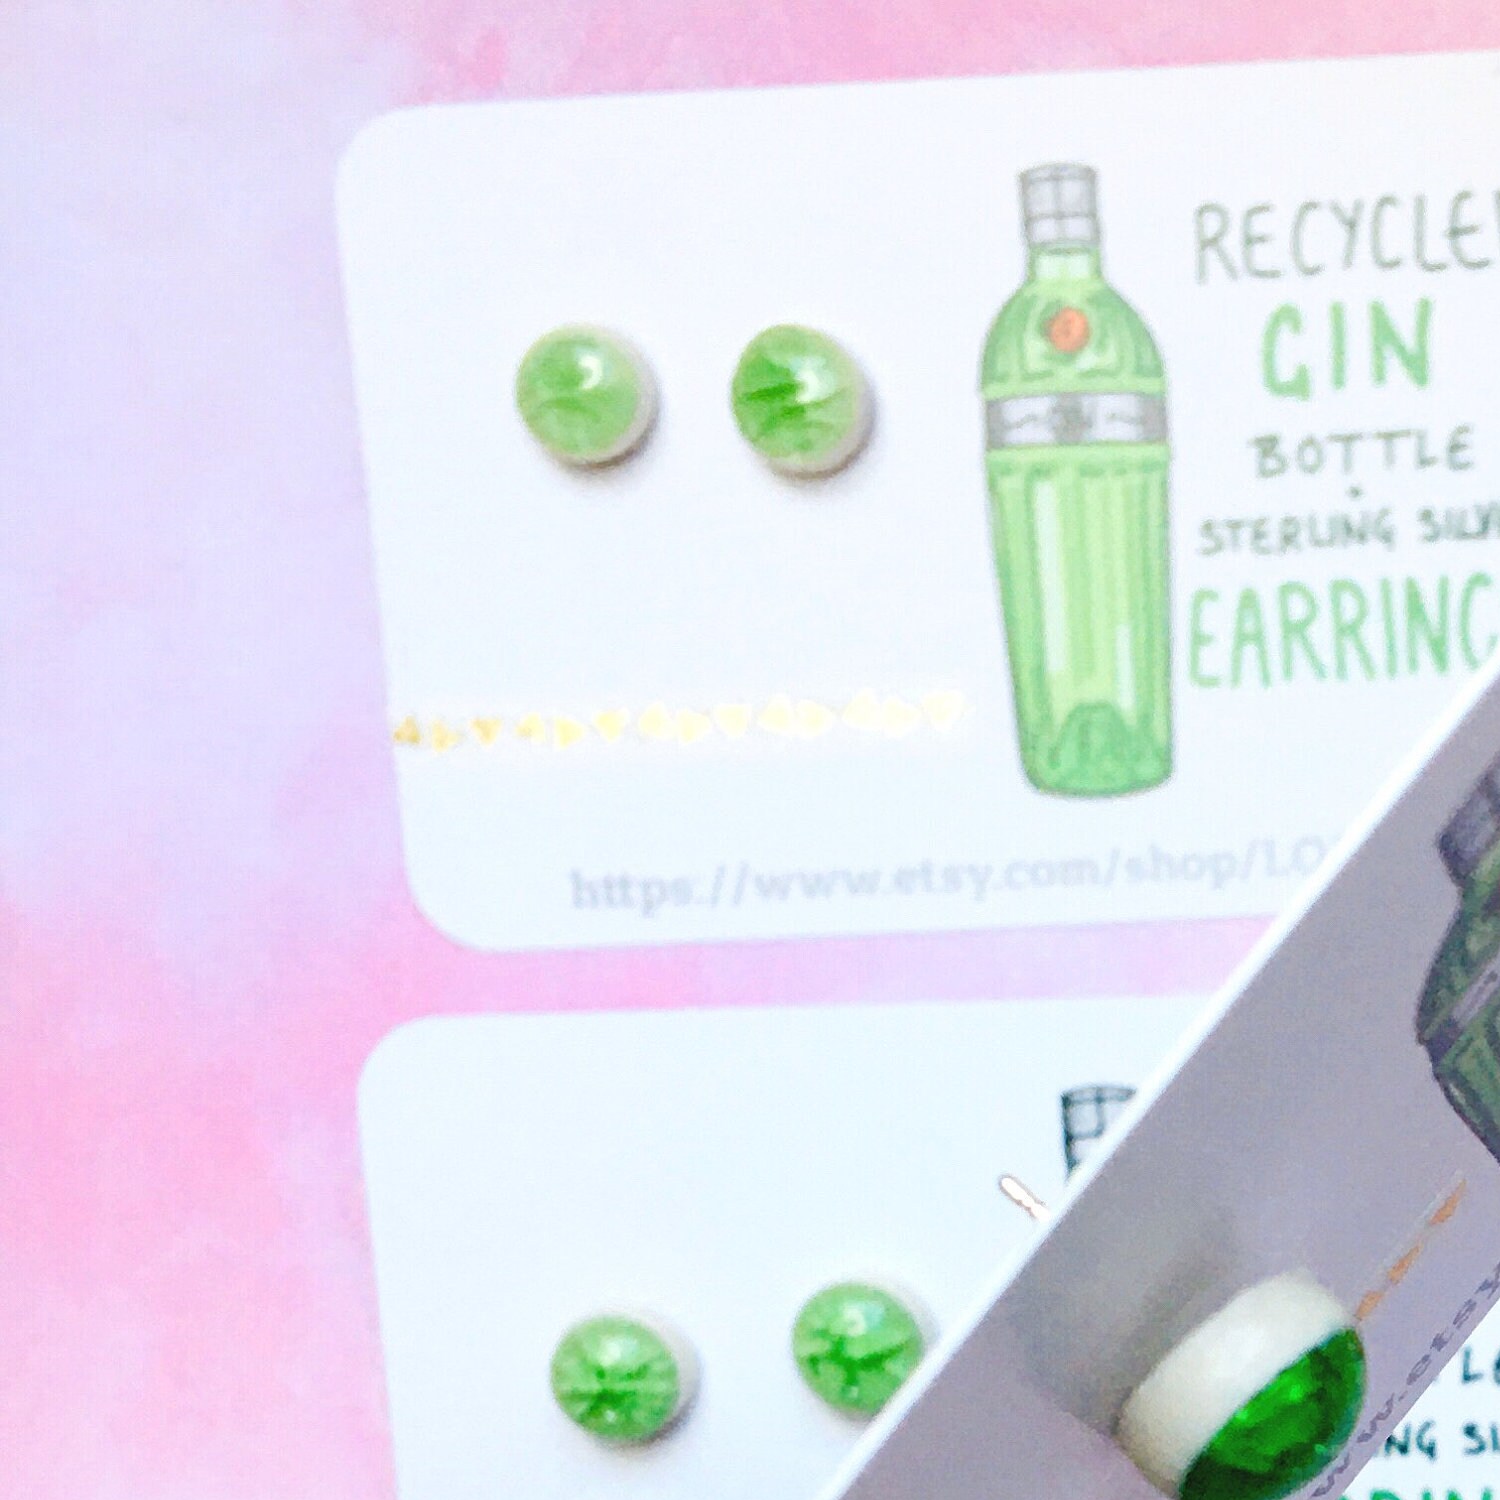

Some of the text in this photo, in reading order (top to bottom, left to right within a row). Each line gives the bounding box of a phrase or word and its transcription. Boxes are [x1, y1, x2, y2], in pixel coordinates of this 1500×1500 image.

[1261, 297, 1435, 400] GIN
[1248, 424, 1476, 478] BOTTLE
[1198, 507, 1397, 556] STERLING
[569, 832, 1340, 918] https://www.etsy.com/shop/LO
